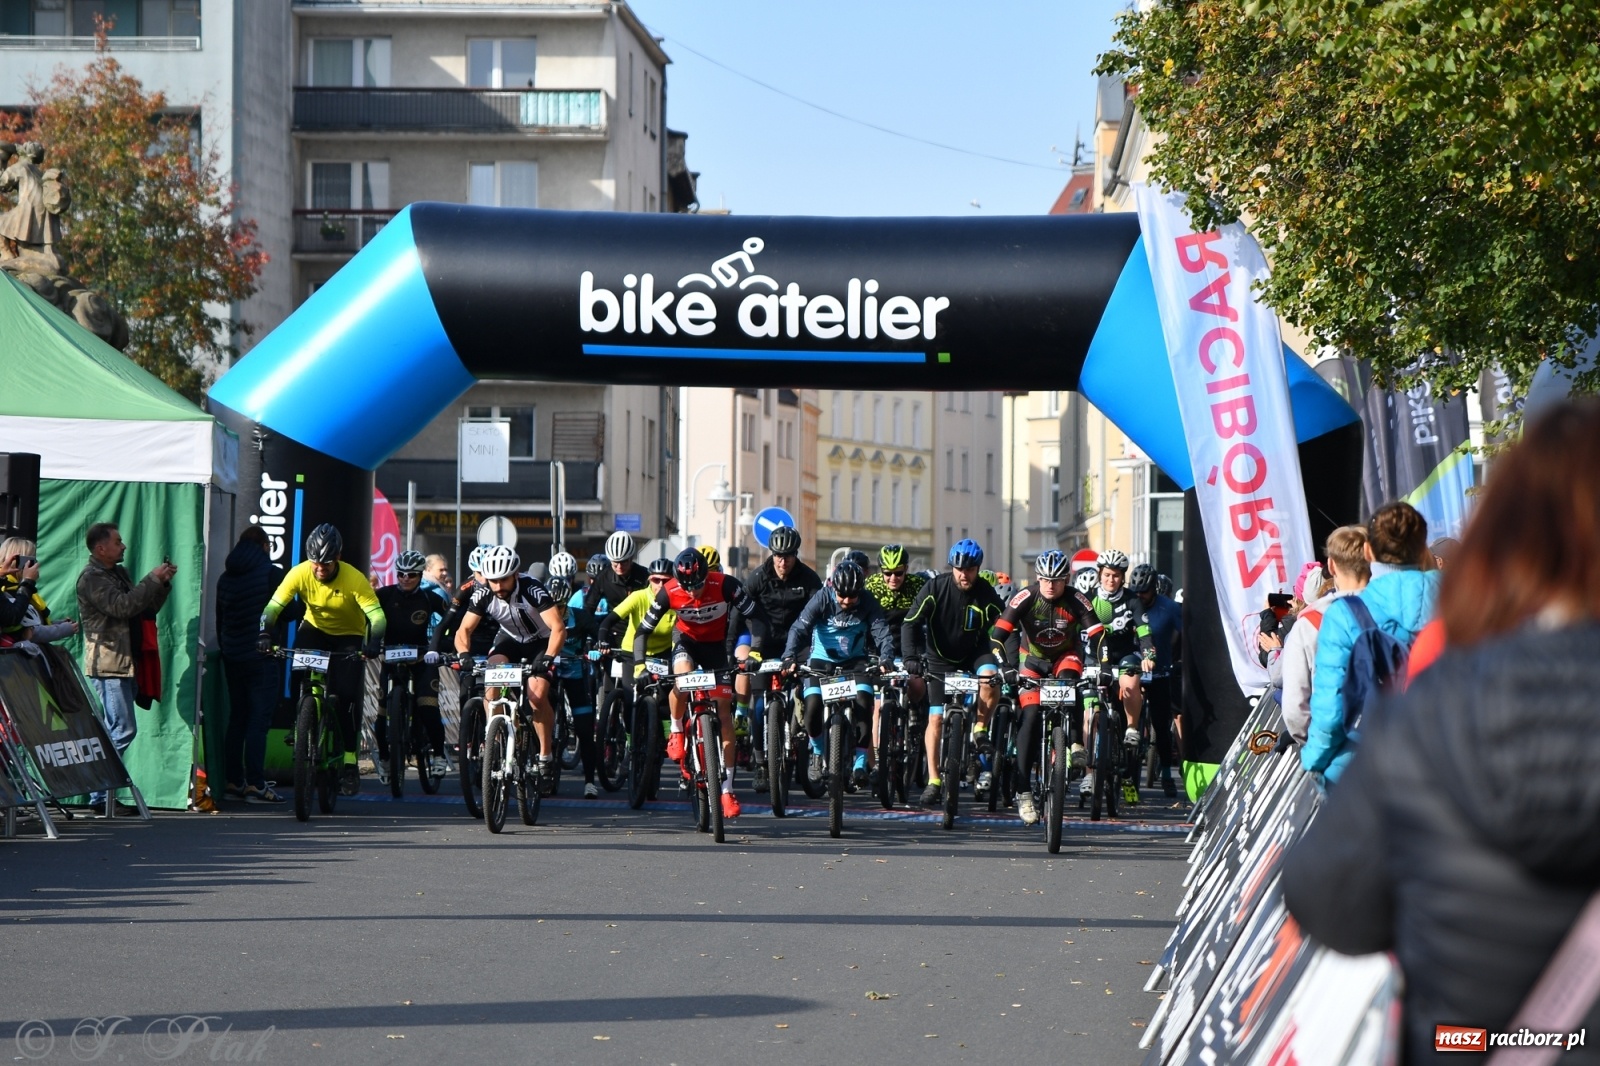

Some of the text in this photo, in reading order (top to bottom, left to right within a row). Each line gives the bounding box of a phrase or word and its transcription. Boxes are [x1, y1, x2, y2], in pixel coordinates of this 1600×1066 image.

[579, 270, 951, 340] bike atelier
[249, 472, 288, 569] elier
[300, 657, 323, 666] 1873
[492, 671, 516, 680] 2676
[685, 675, 709, 684] 1472
[828, 685, 852, 696] 2254
[1046, 690, 1070, 699] 1236
[35, 737, 106, 769] MERIDA
